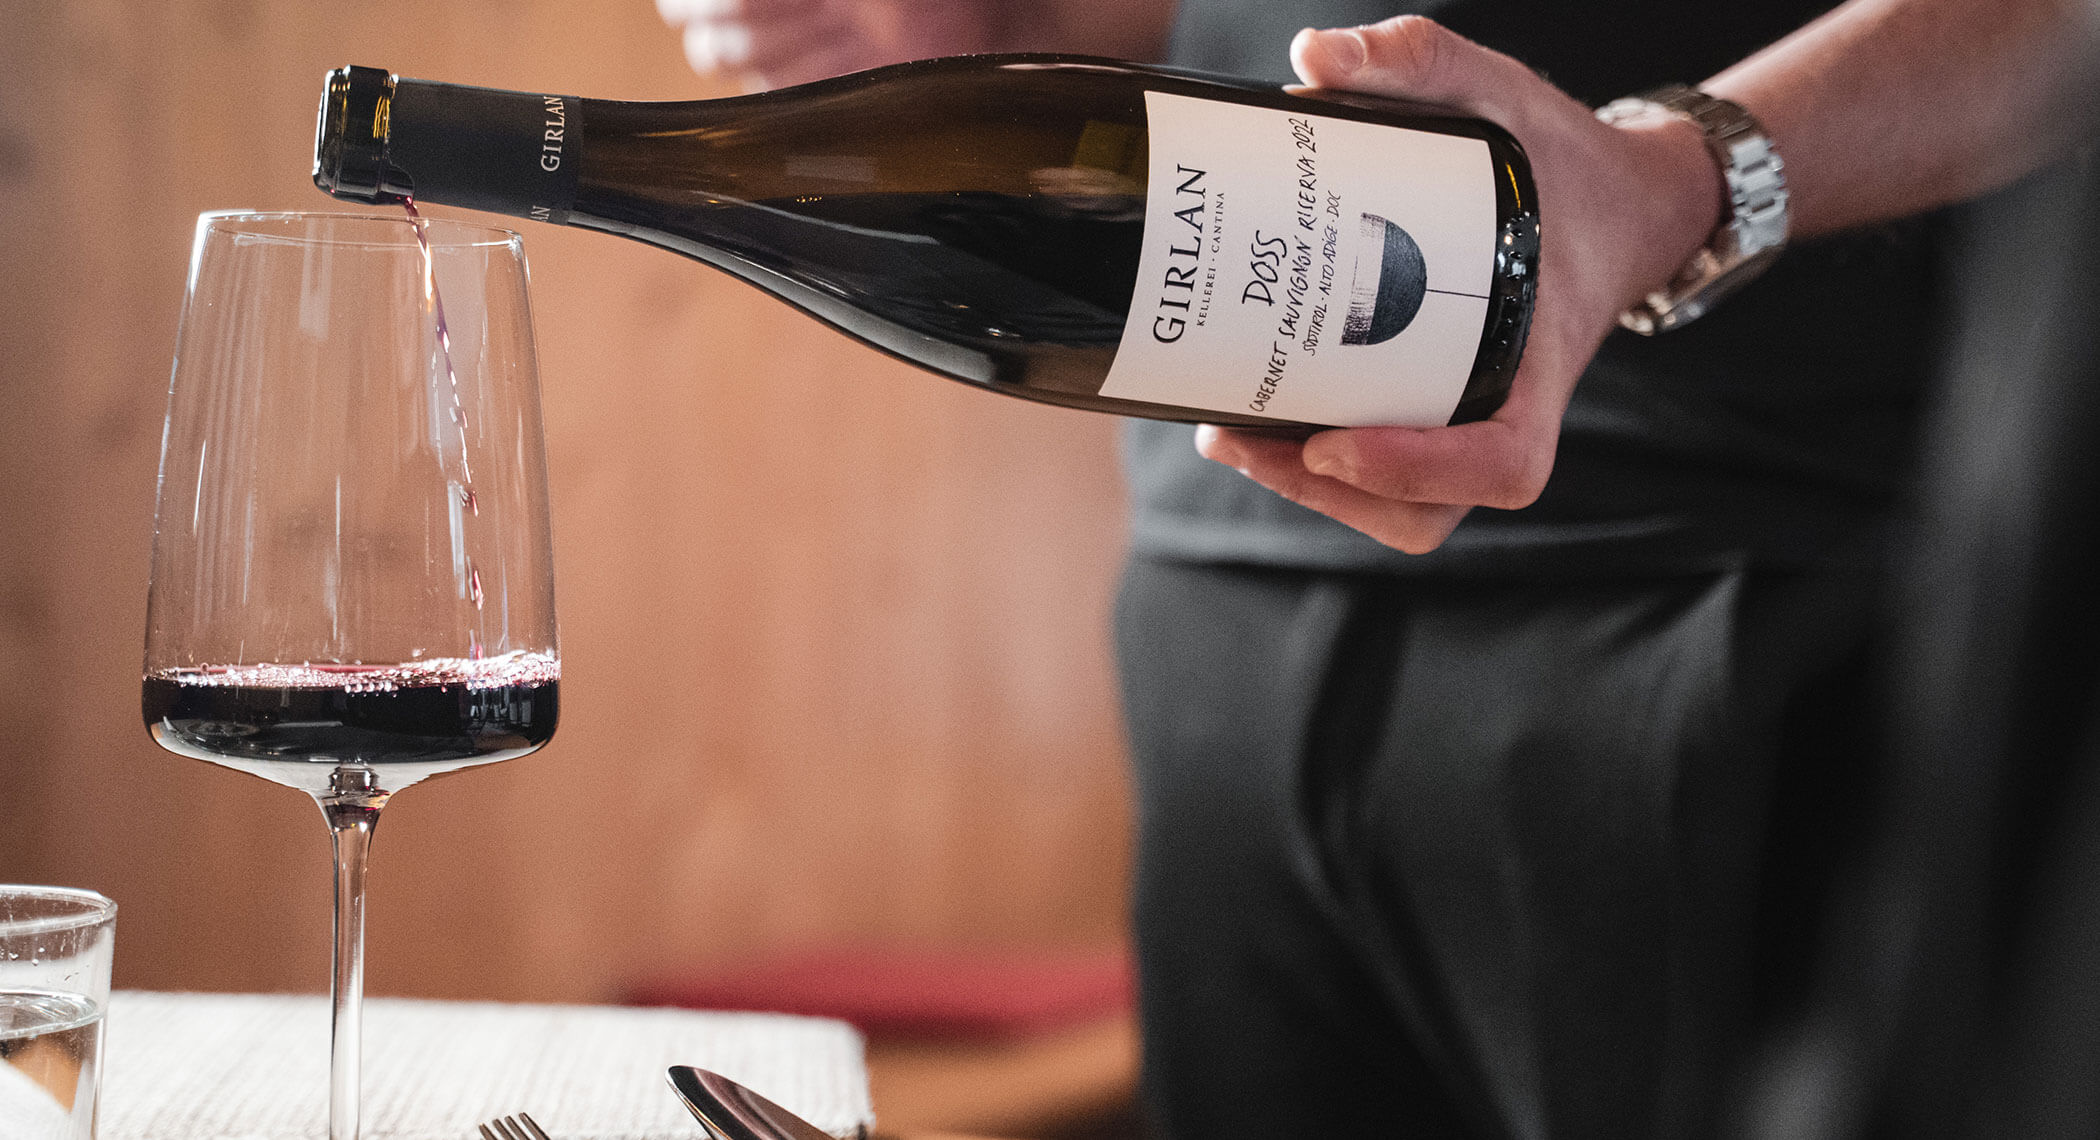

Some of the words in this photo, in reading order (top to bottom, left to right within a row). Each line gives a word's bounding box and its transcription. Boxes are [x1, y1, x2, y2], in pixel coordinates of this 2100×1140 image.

[540, 96, 565, 172] GIRLAN
[1287, 117, 1317, 153] 2022
[1297, 154, 1319, 231] RISERVA
[1327, 190, 1342, 219] DOC
[1153, 163, 1207, 343] GIRLAN
[1196, 267, 1217, 327] KELLEREI
[1211, 192, 1225, 254] CANTINA
[1242, 229, 1288, 307] DOSS
[1278, 236, 1312, 340] SAUVIGNON
[1321, 264, 1335, 296] ALTO
[1302, 303, 1328, 357] SÜDTIROL
[1248, 340, 1288, 412] CABERNET
